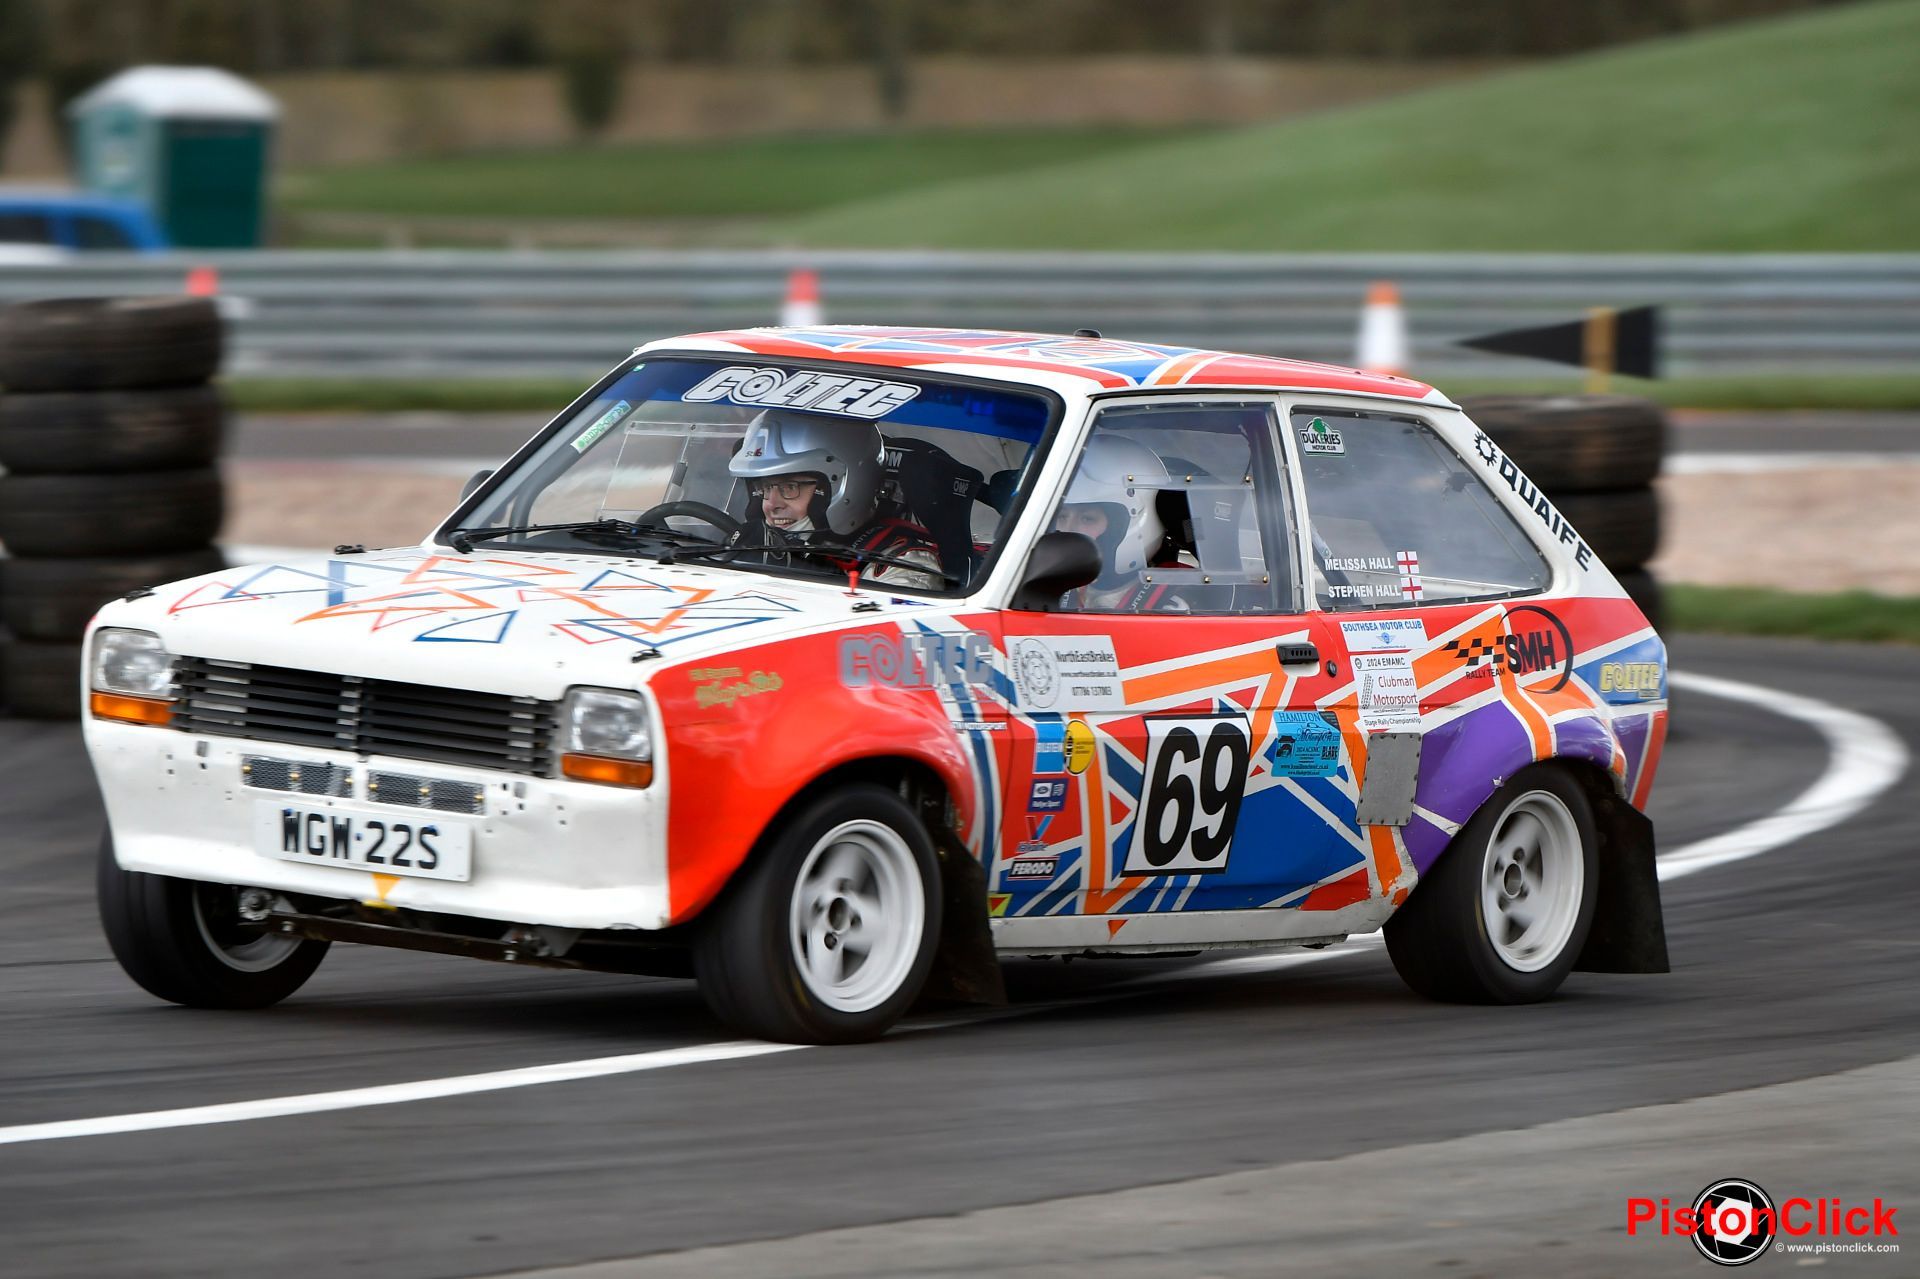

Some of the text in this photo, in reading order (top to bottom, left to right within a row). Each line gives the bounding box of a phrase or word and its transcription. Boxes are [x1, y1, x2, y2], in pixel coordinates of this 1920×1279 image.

[681, 366, 922, 419] COLTEC
[1302, 433, 1341, 445] DUKERIES
[1499, 454, 1592, 572] QUAIFE
[1324, 557, 1394, 571] MELISSA HALL
[1328, 584, 1401, 598] STEPHEN HALL
[1342, 620, 1422, 632] SOUTHSEA MOTOR CLUB
[1504, 630, 1557, 674] SMH
[838, 630, 993, 689] COLTEC
[1367, 657, 1406, 667] 2024 EMAMC
[1466, 667, 1506, 680] RALLY TEAM
[1600, 662, 1660, 691] COLTEC
[1378, 676, 1415, 688] Clubman
[1373, 692, 1419, 708] Motorsport
[1279, 712, 1321, 722] HAMILTON
[1364, 716, 1422, 727] Stage Rally Championship
[1144, 722, 1249, 866] 69
[282, 809, 439, 870] WGW 22S
[1011, 862, 1054, 875] FERODO
